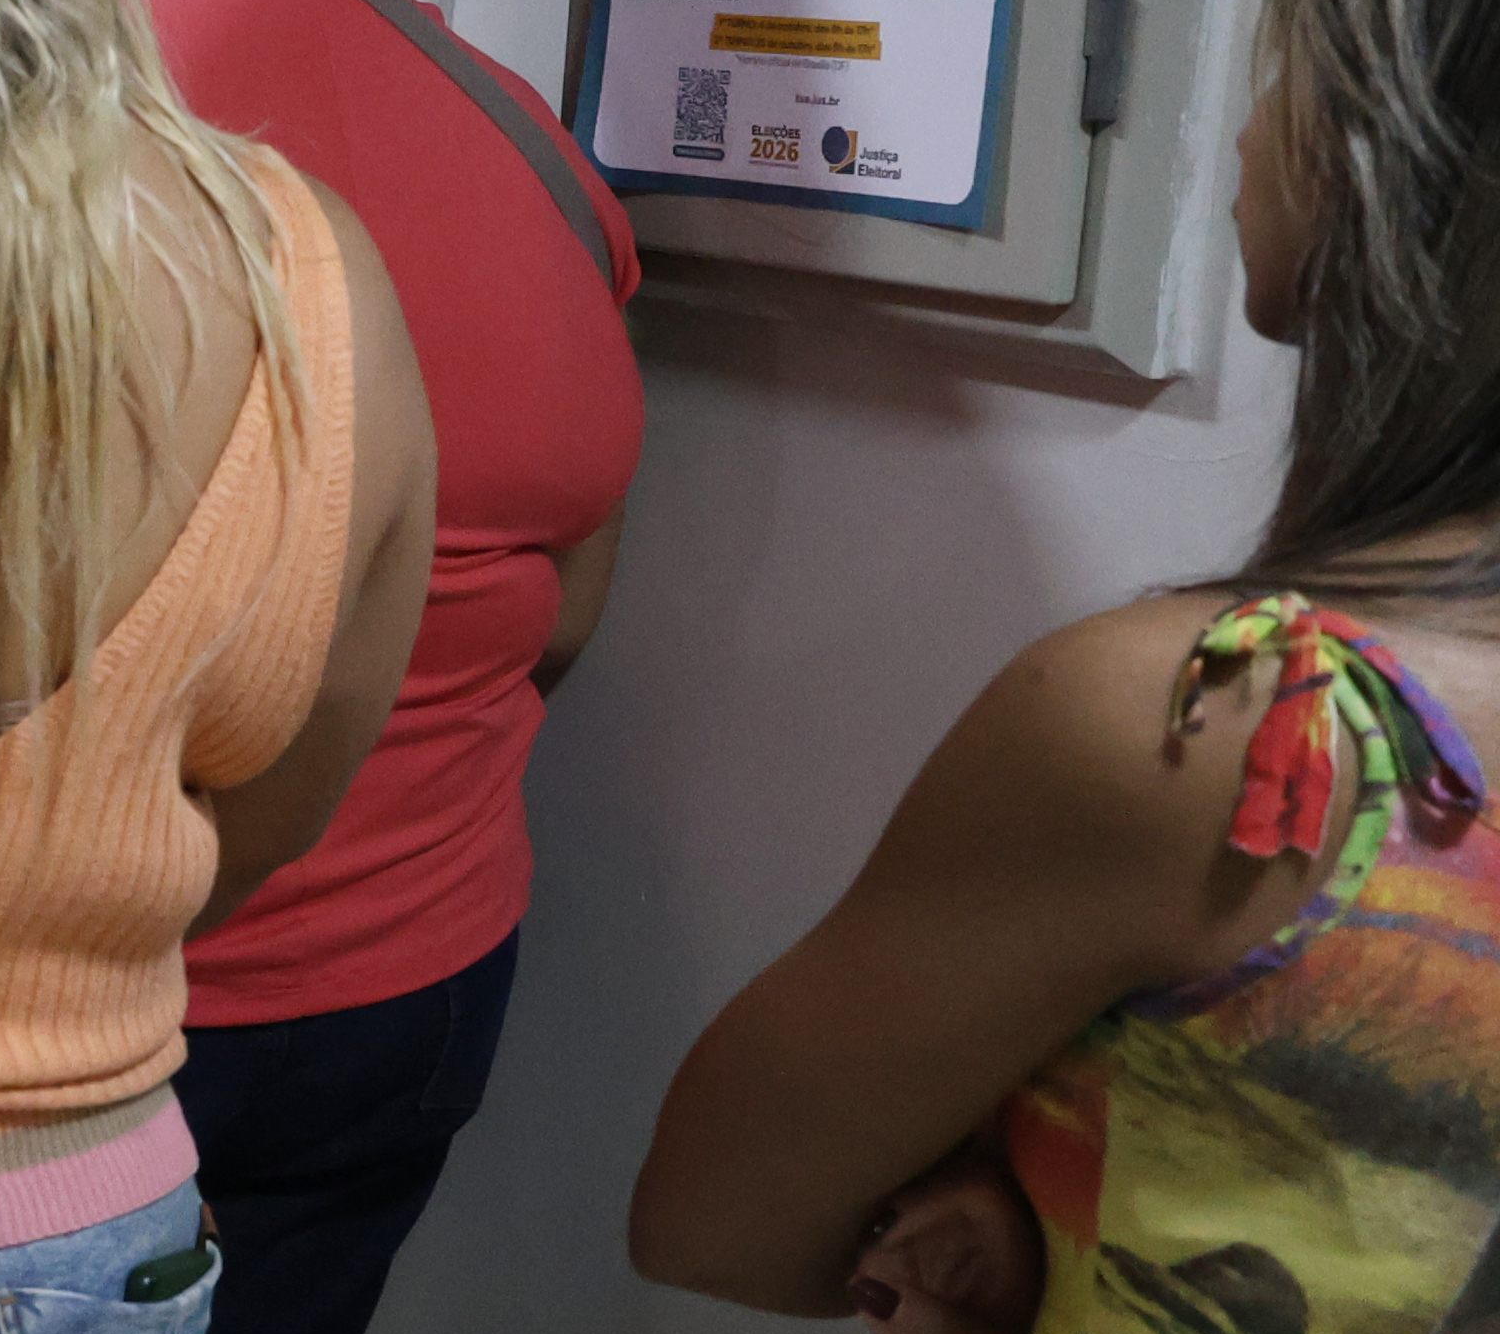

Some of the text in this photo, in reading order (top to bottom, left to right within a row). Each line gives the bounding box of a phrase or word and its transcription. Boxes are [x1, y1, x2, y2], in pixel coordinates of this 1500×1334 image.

[751, 124, 802, 139] ELEIÇÕES
[749, 138, 800, 162] 2026
[859, 147, 899, 165] Justiça
[857, 164, 902, 180] Eleitoral
